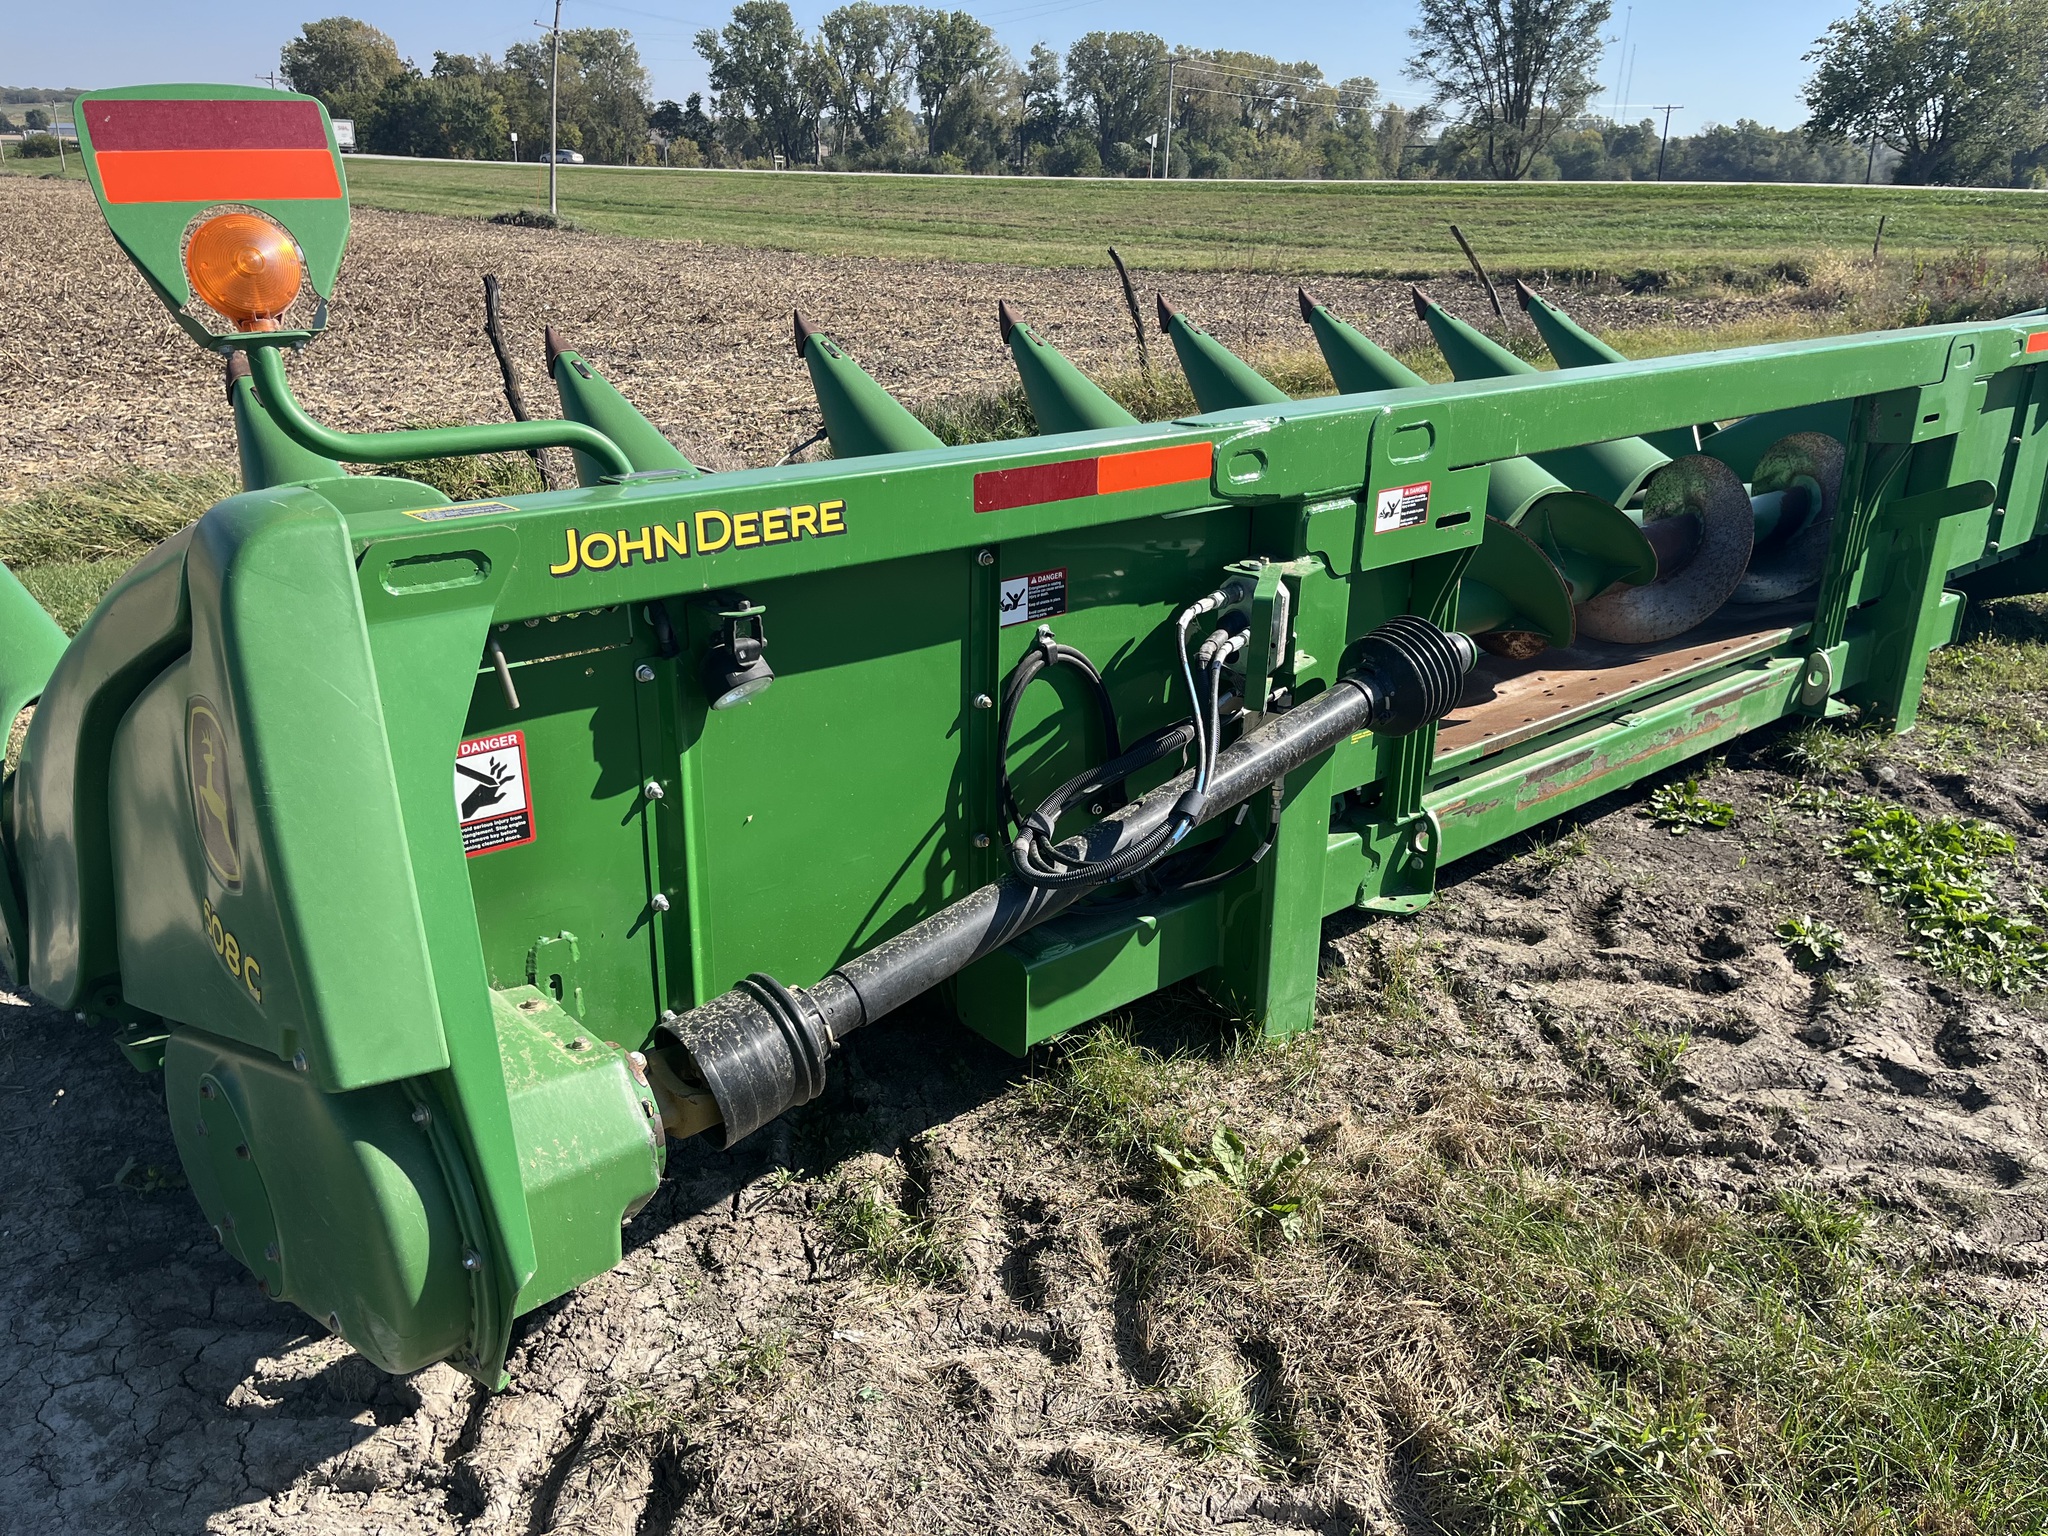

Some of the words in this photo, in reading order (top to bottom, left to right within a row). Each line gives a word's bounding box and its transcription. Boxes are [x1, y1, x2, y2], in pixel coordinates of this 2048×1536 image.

[550, 521, 691, 577] JOHN
[694, 499, 847, 555] DEERE
[1038, 572, 1063, 583] DANGER
[461, 734, 518, 755] DANGER
[473, 822, 493, 830] serious
[494, 818, 509, 826] injury
[509, 820, 526, 828] engine
[469, 835, 489, 844] remove
[482, 837, 505, 847] cleanout
